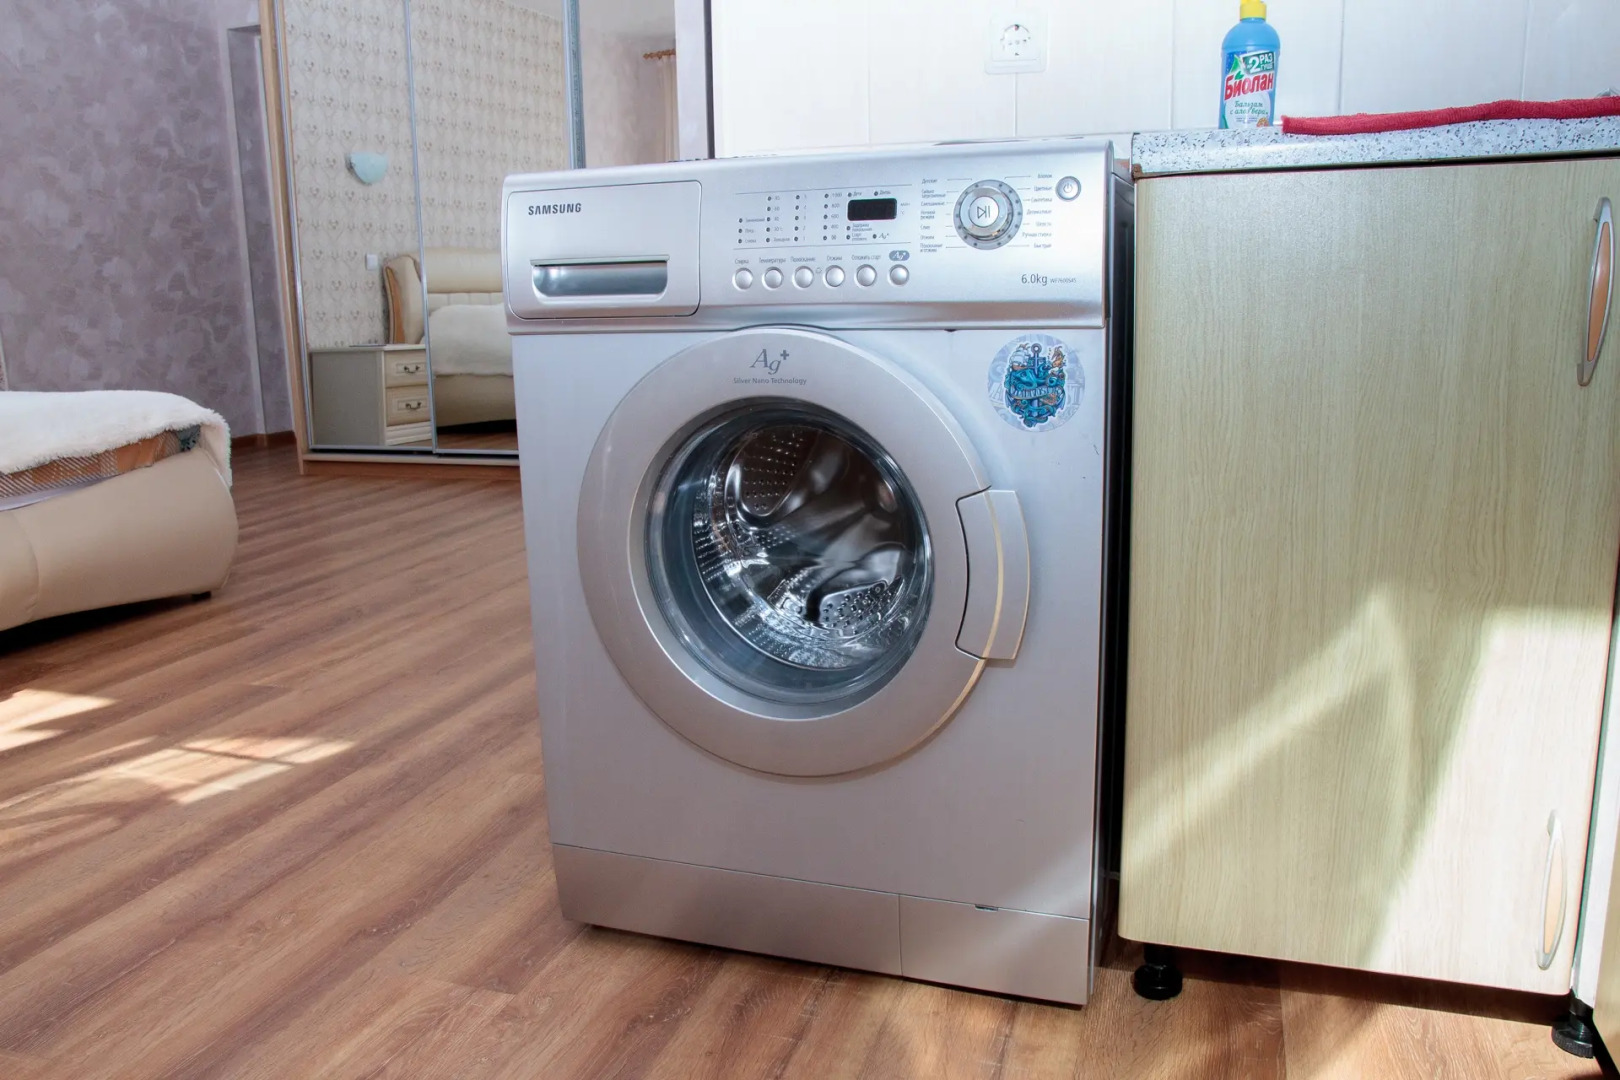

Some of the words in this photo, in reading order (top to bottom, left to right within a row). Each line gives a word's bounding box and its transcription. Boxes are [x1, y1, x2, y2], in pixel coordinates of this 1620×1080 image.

[1248, 56, 1260, 73] 2
[1224, 73, 1274, 100] Биолан
[528, 202, 582, 216] SAMSUNG
[1021, 273, 1048, 286] 6.0kg
[748, 348, 790, 375] Ag+
[771, 377, 807, 385] Technology
